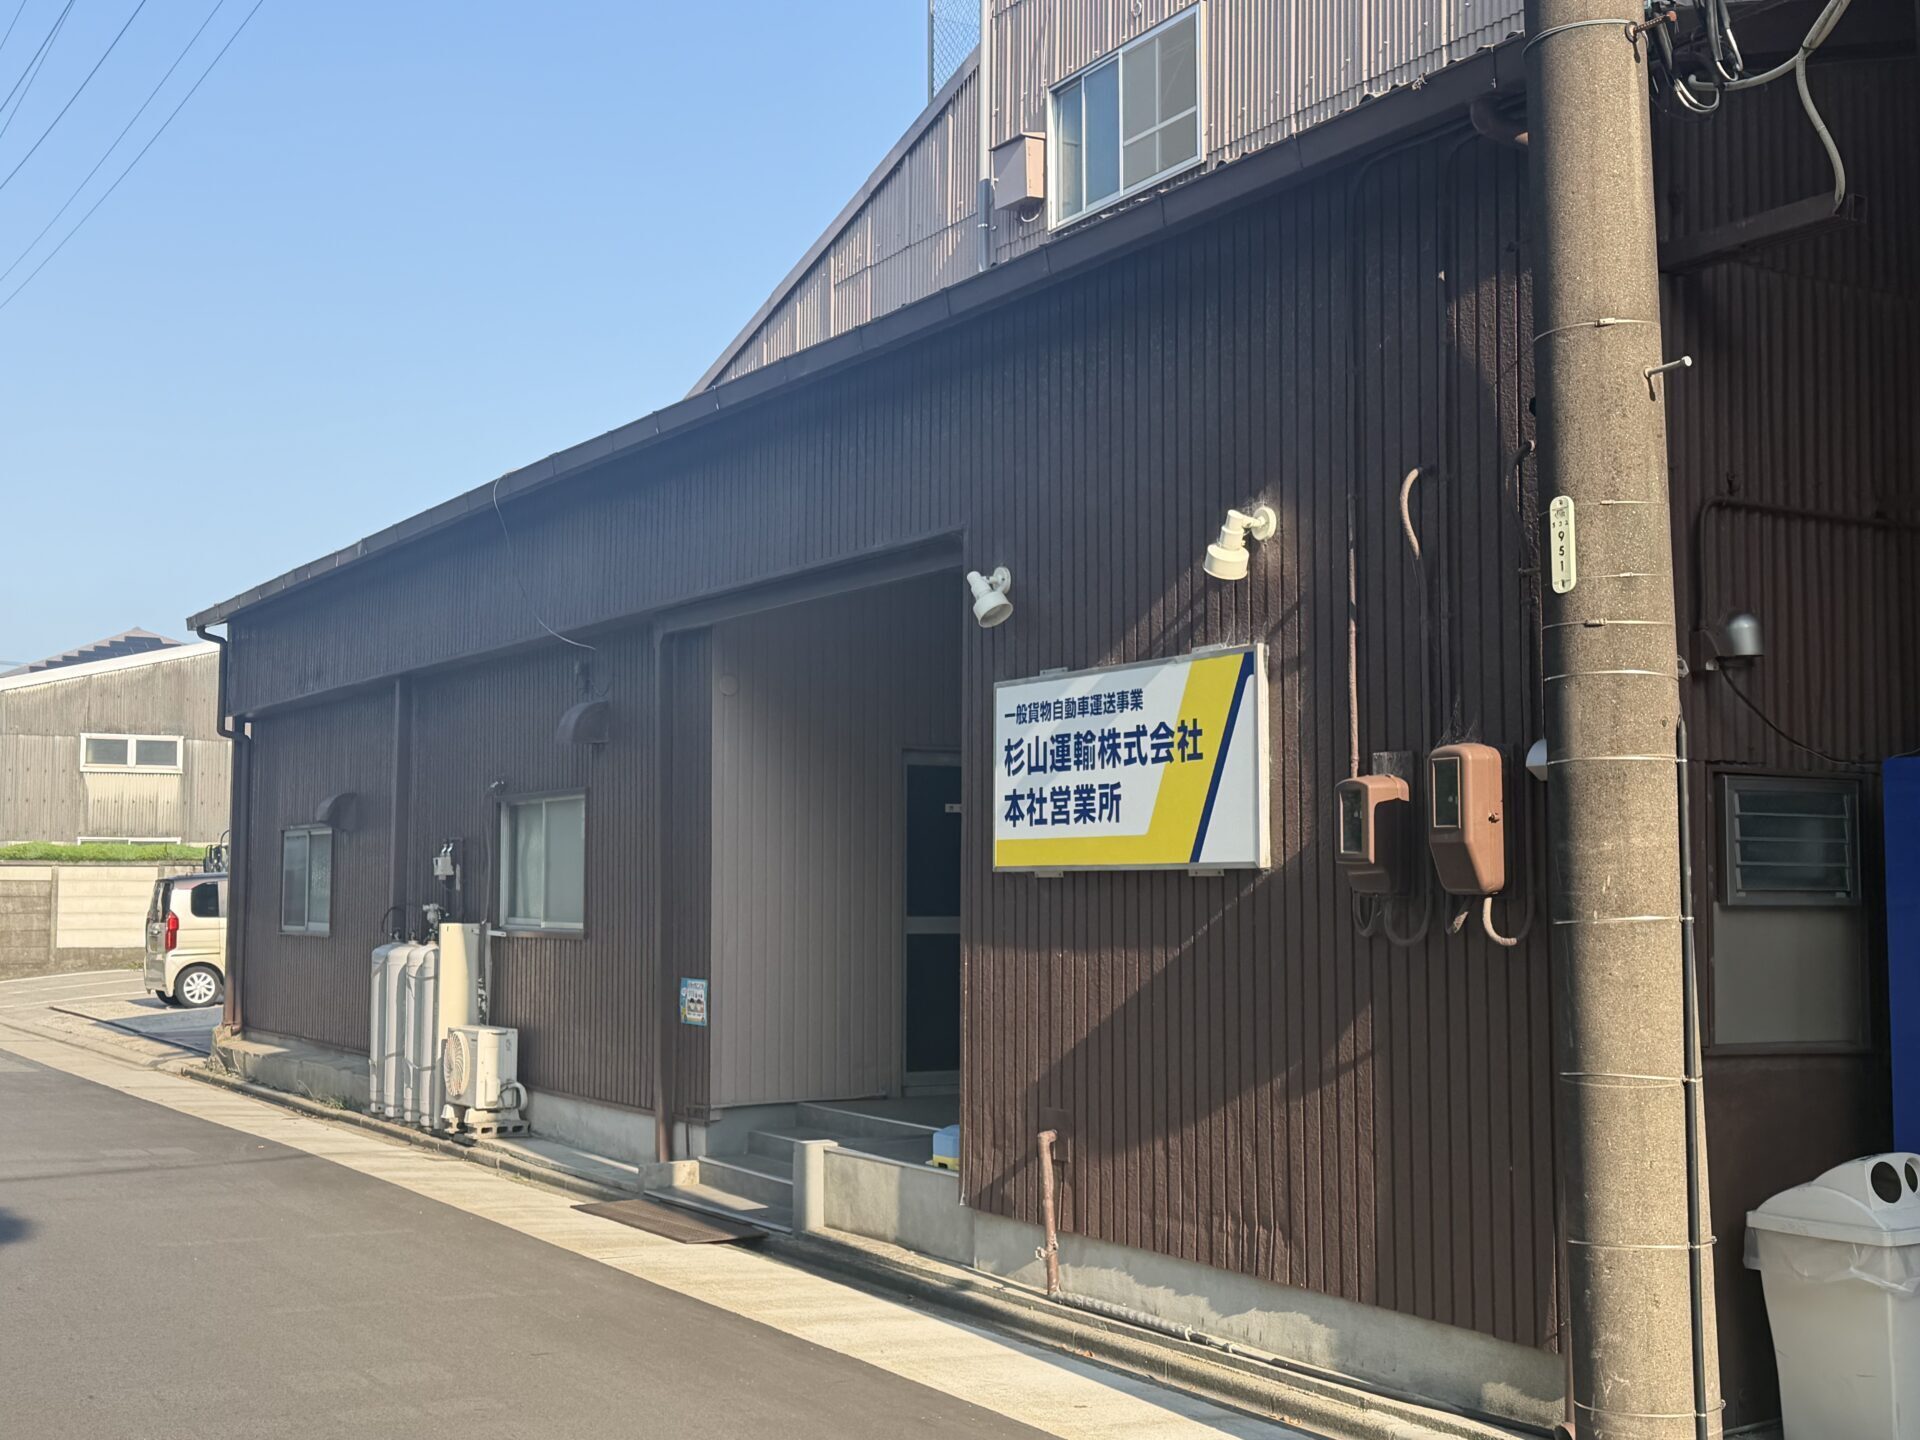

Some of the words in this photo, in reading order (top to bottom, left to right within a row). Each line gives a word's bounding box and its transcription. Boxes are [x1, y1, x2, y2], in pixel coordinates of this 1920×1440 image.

[1004, 688, 1144, 725] 一般貨物自動車運送事業
[1004, 718, 1204, 777] 杉山運輸株式会社
[1004, 781, 1122, 828] 本社営業所
